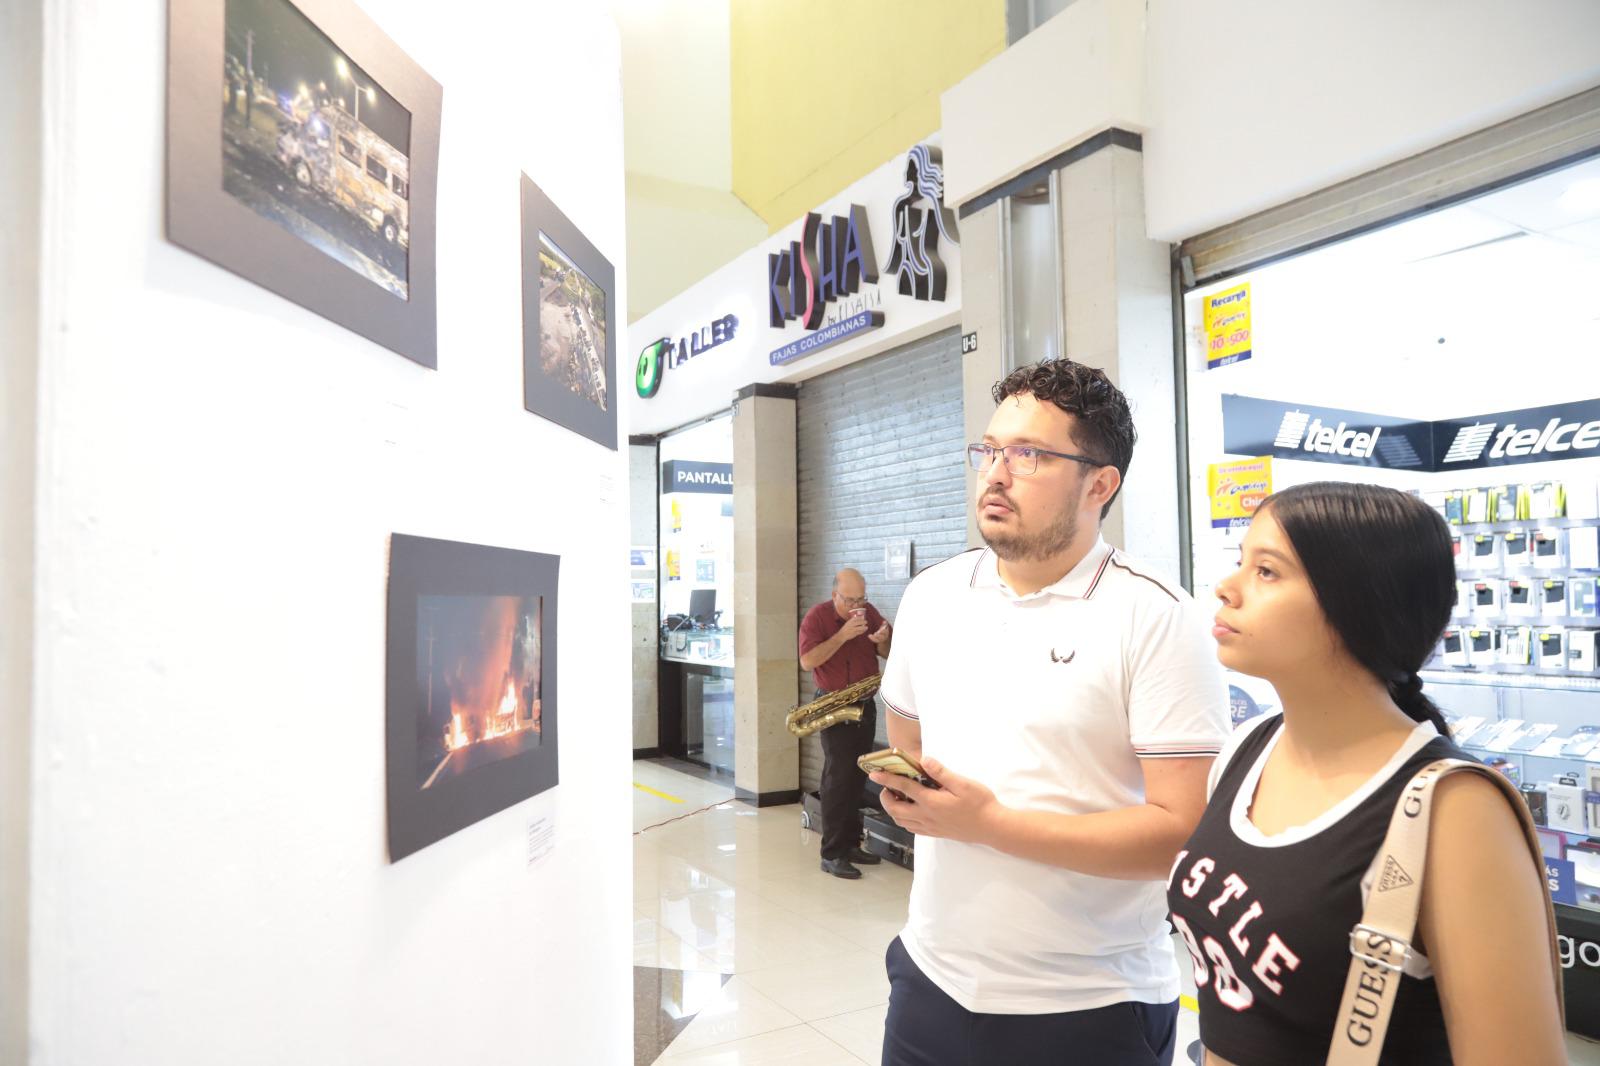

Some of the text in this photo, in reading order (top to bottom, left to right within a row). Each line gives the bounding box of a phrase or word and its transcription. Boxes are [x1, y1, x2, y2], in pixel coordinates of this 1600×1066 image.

[768, 203, 878, 331] KISHA
[1211, 290, 1247, 308] Recarga
[664, 313, 740, 370] TALLER
[772, 315, 867, 363] FAJAS COLOMBIANAS
[962, 334, 977, 352] U-6
[1303, 418, 1382, 458] telcel
[1489, 417, 1600, 459] telce
[1346, 933, 1393, 1048] GUESS
